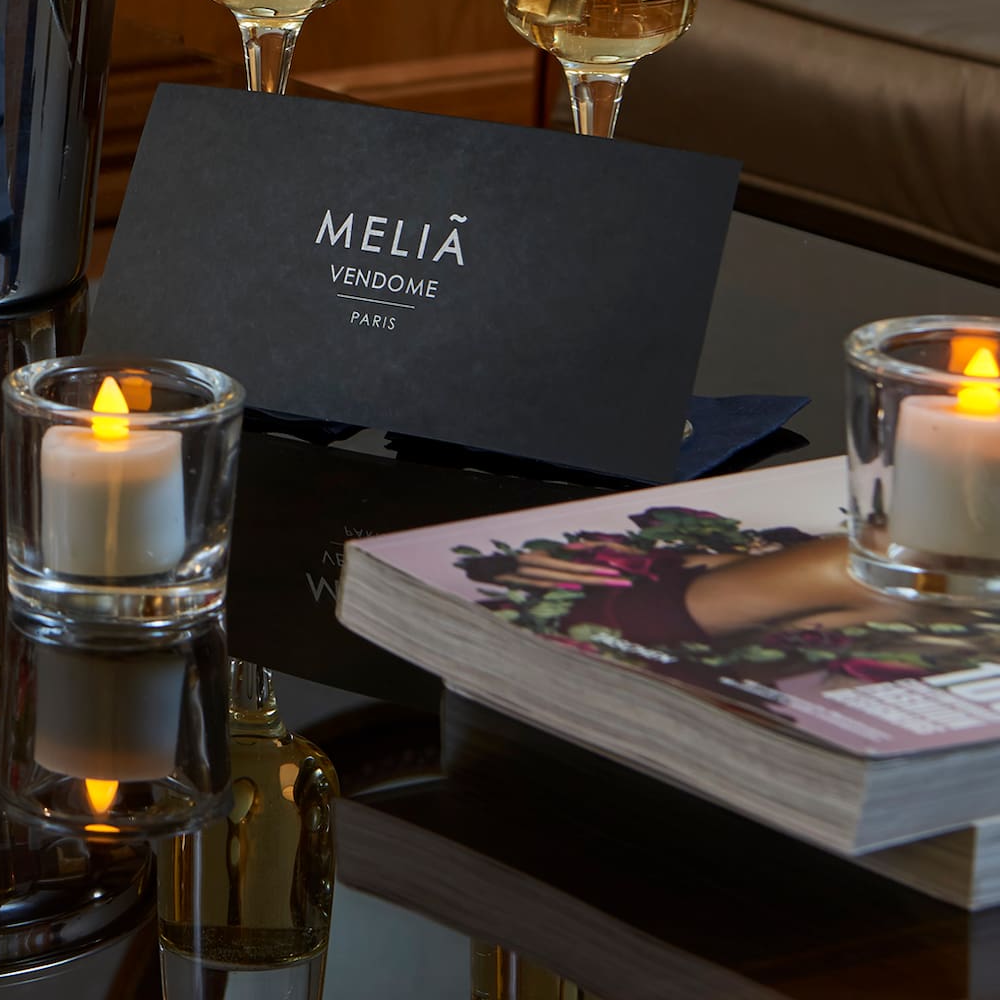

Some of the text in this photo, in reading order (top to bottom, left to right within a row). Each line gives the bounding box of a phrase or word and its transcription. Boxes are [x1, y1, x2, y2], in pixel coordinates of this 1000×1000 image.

[316, 210, 467, 265] MELIÃ
[331, 264, 438, 298] VENDOME
[351, 312, 395, 330] PARIS
